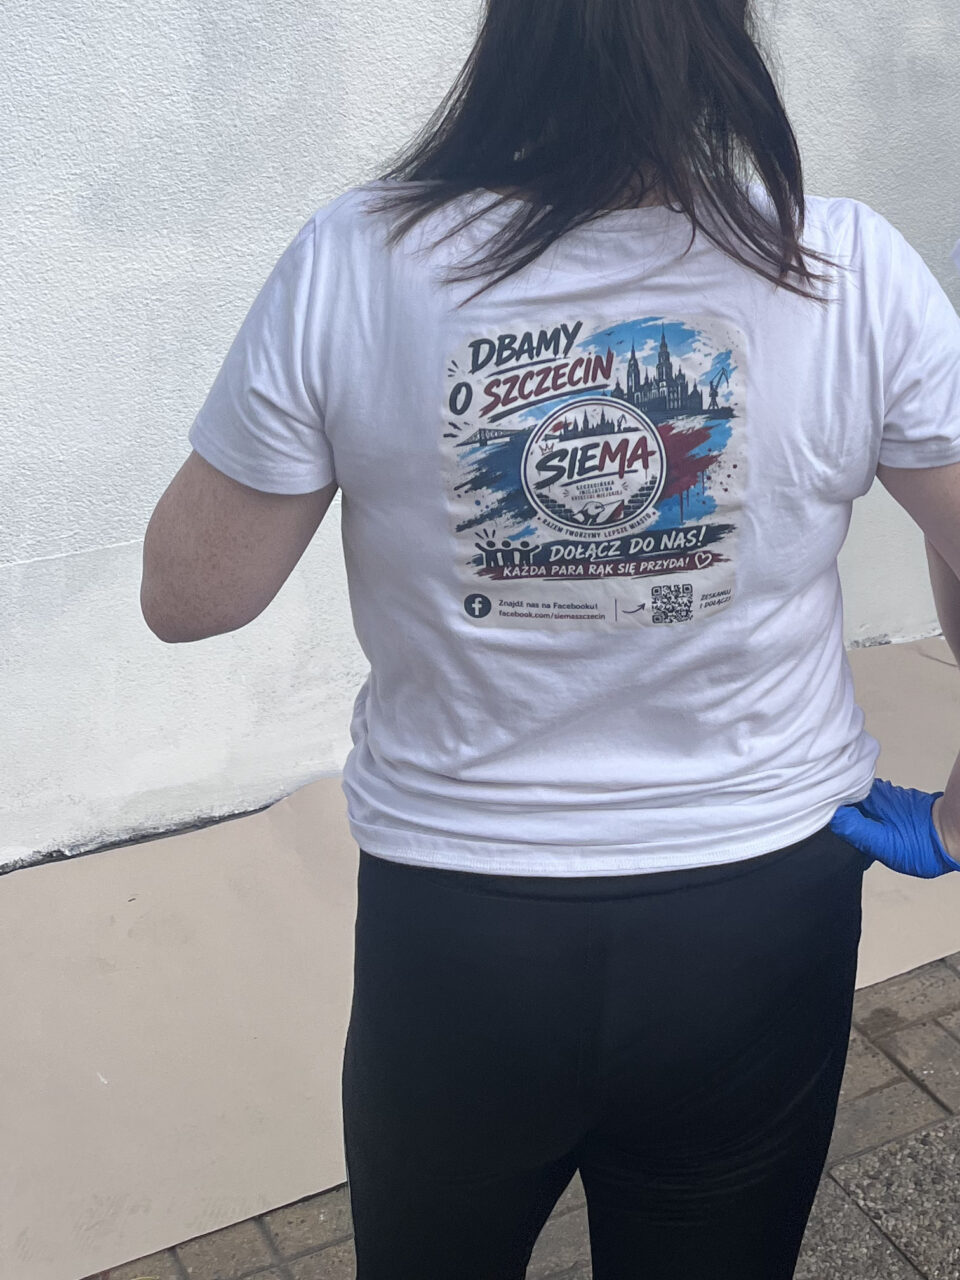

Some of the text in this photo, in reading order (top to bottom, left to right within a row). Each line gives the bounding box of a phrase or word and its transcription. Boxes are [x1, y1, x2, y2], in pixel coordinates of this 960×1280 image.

[468, 320, 583, 375] DBAMY
[448, 381, 473, 416] O
[533, 435, 657, 491] SIEMA
[542, 513, 652, 539] RAZEM TWORZYMY LEPSZE MIASTO
[549, 526, 707, 562] DOŁĄCZ DO NAS!
[503, 557, 690, 578] KAŻDA PARA RĄK SIĘ PRZYDA!
[498, 610, 606, 620] facebook.com/siemaszczecin
[553, 602, 598, 610] Facebooku!
